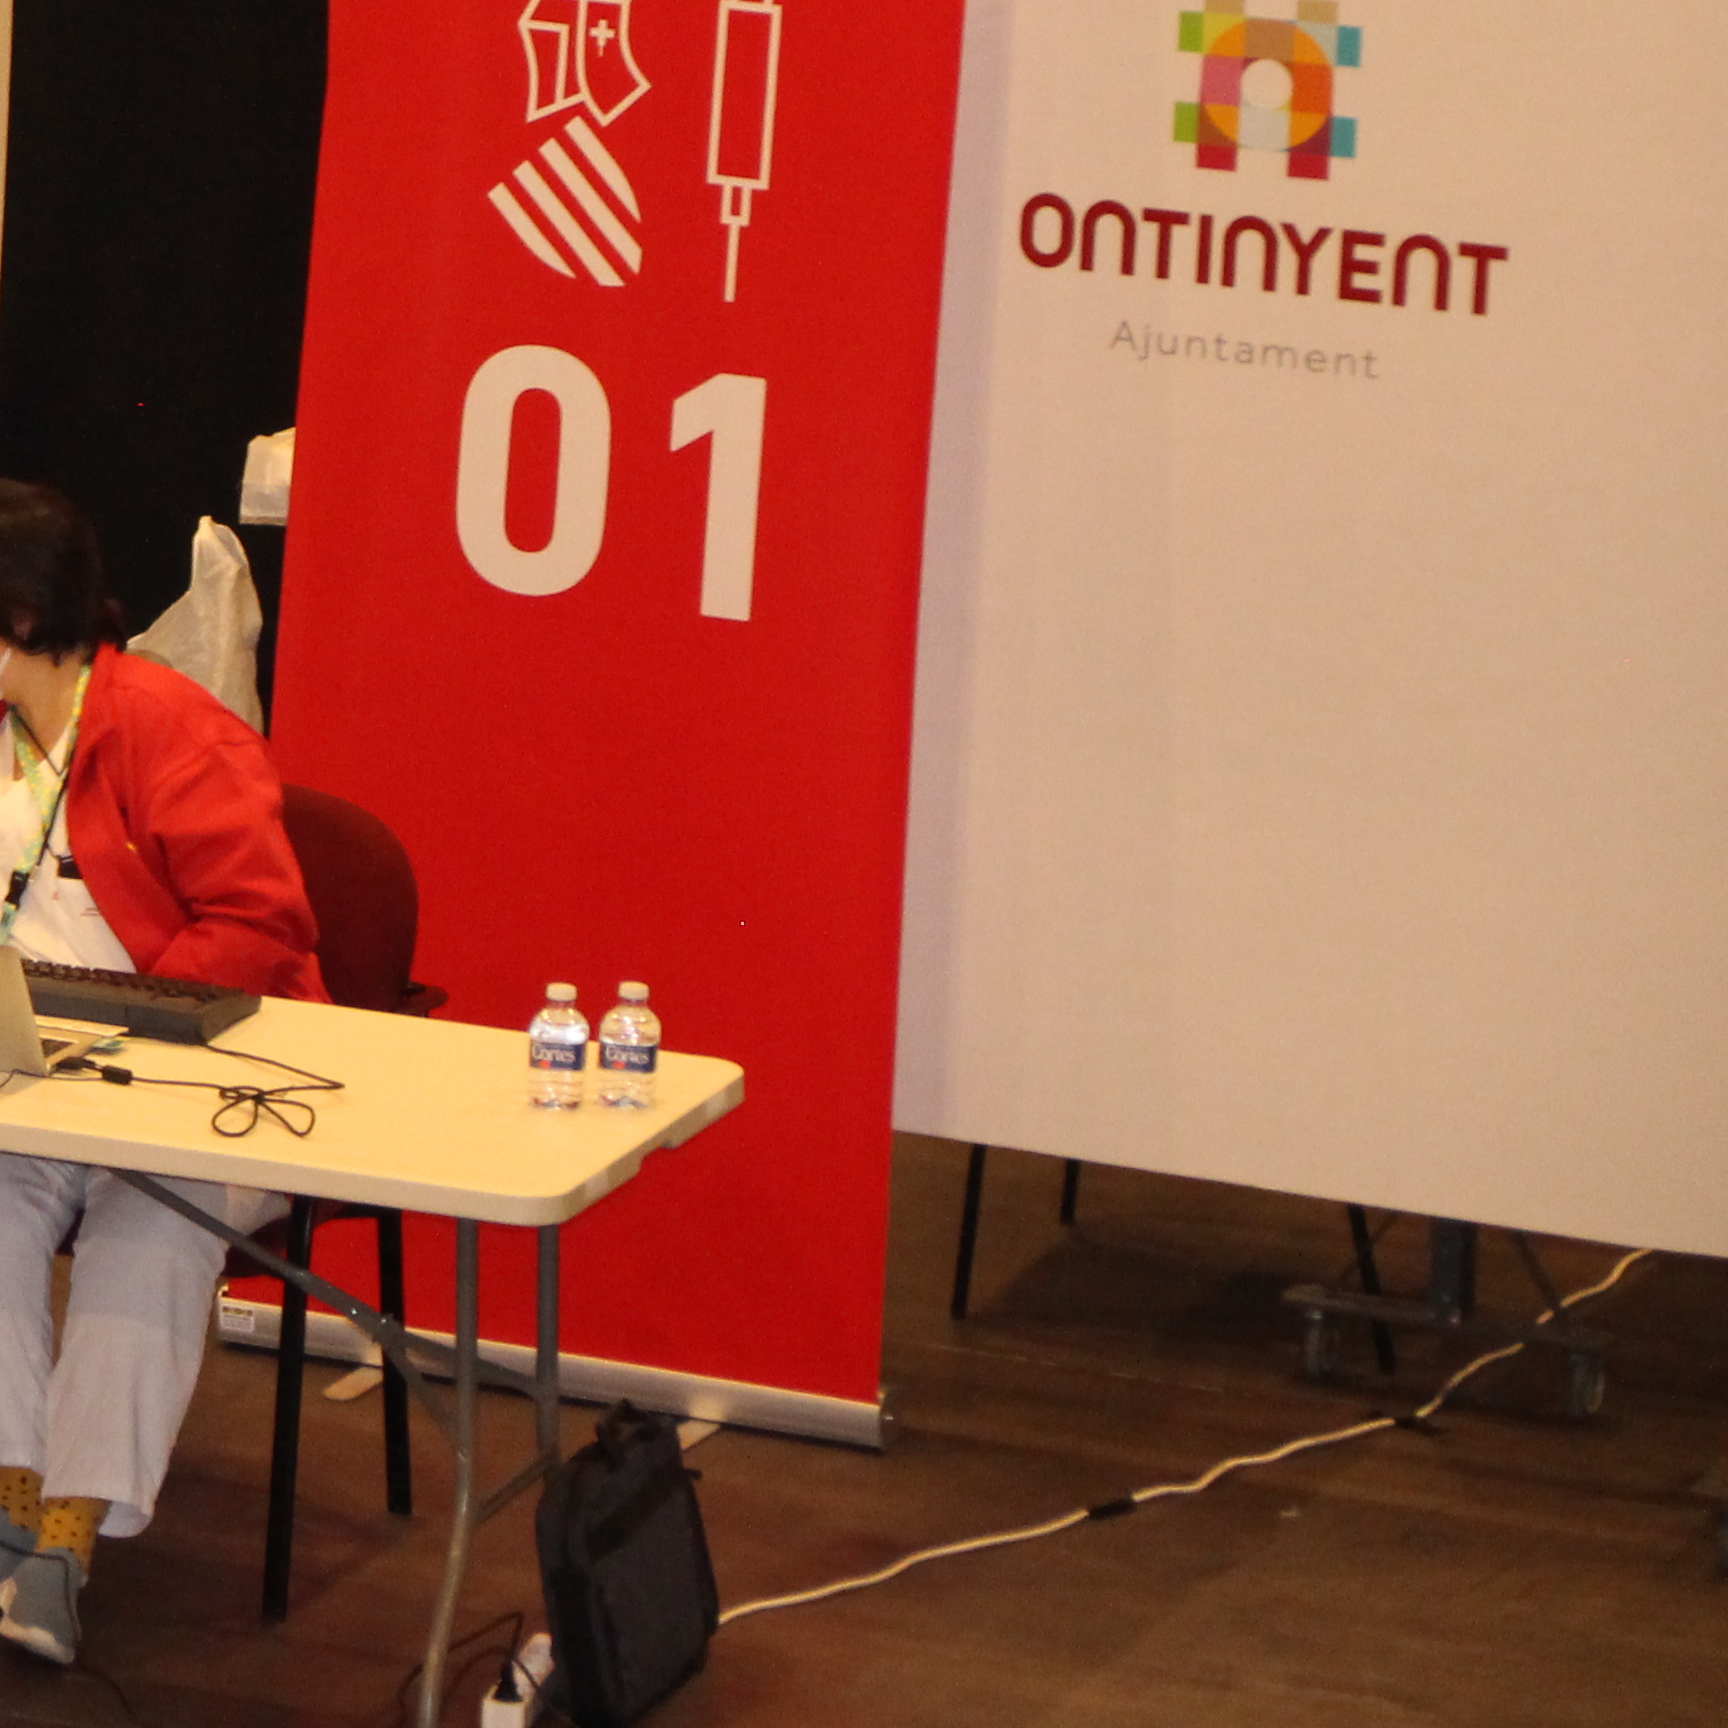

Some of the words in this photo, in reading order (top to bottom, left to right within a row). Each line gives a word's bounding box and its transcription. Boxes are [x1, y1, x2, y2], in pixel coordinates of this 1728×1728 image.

[1019, 192, 1509, 317] ONTINYENT
[1110, 319, 1380, 380] Ajuntament
[455, 344, 768, 622] 01
